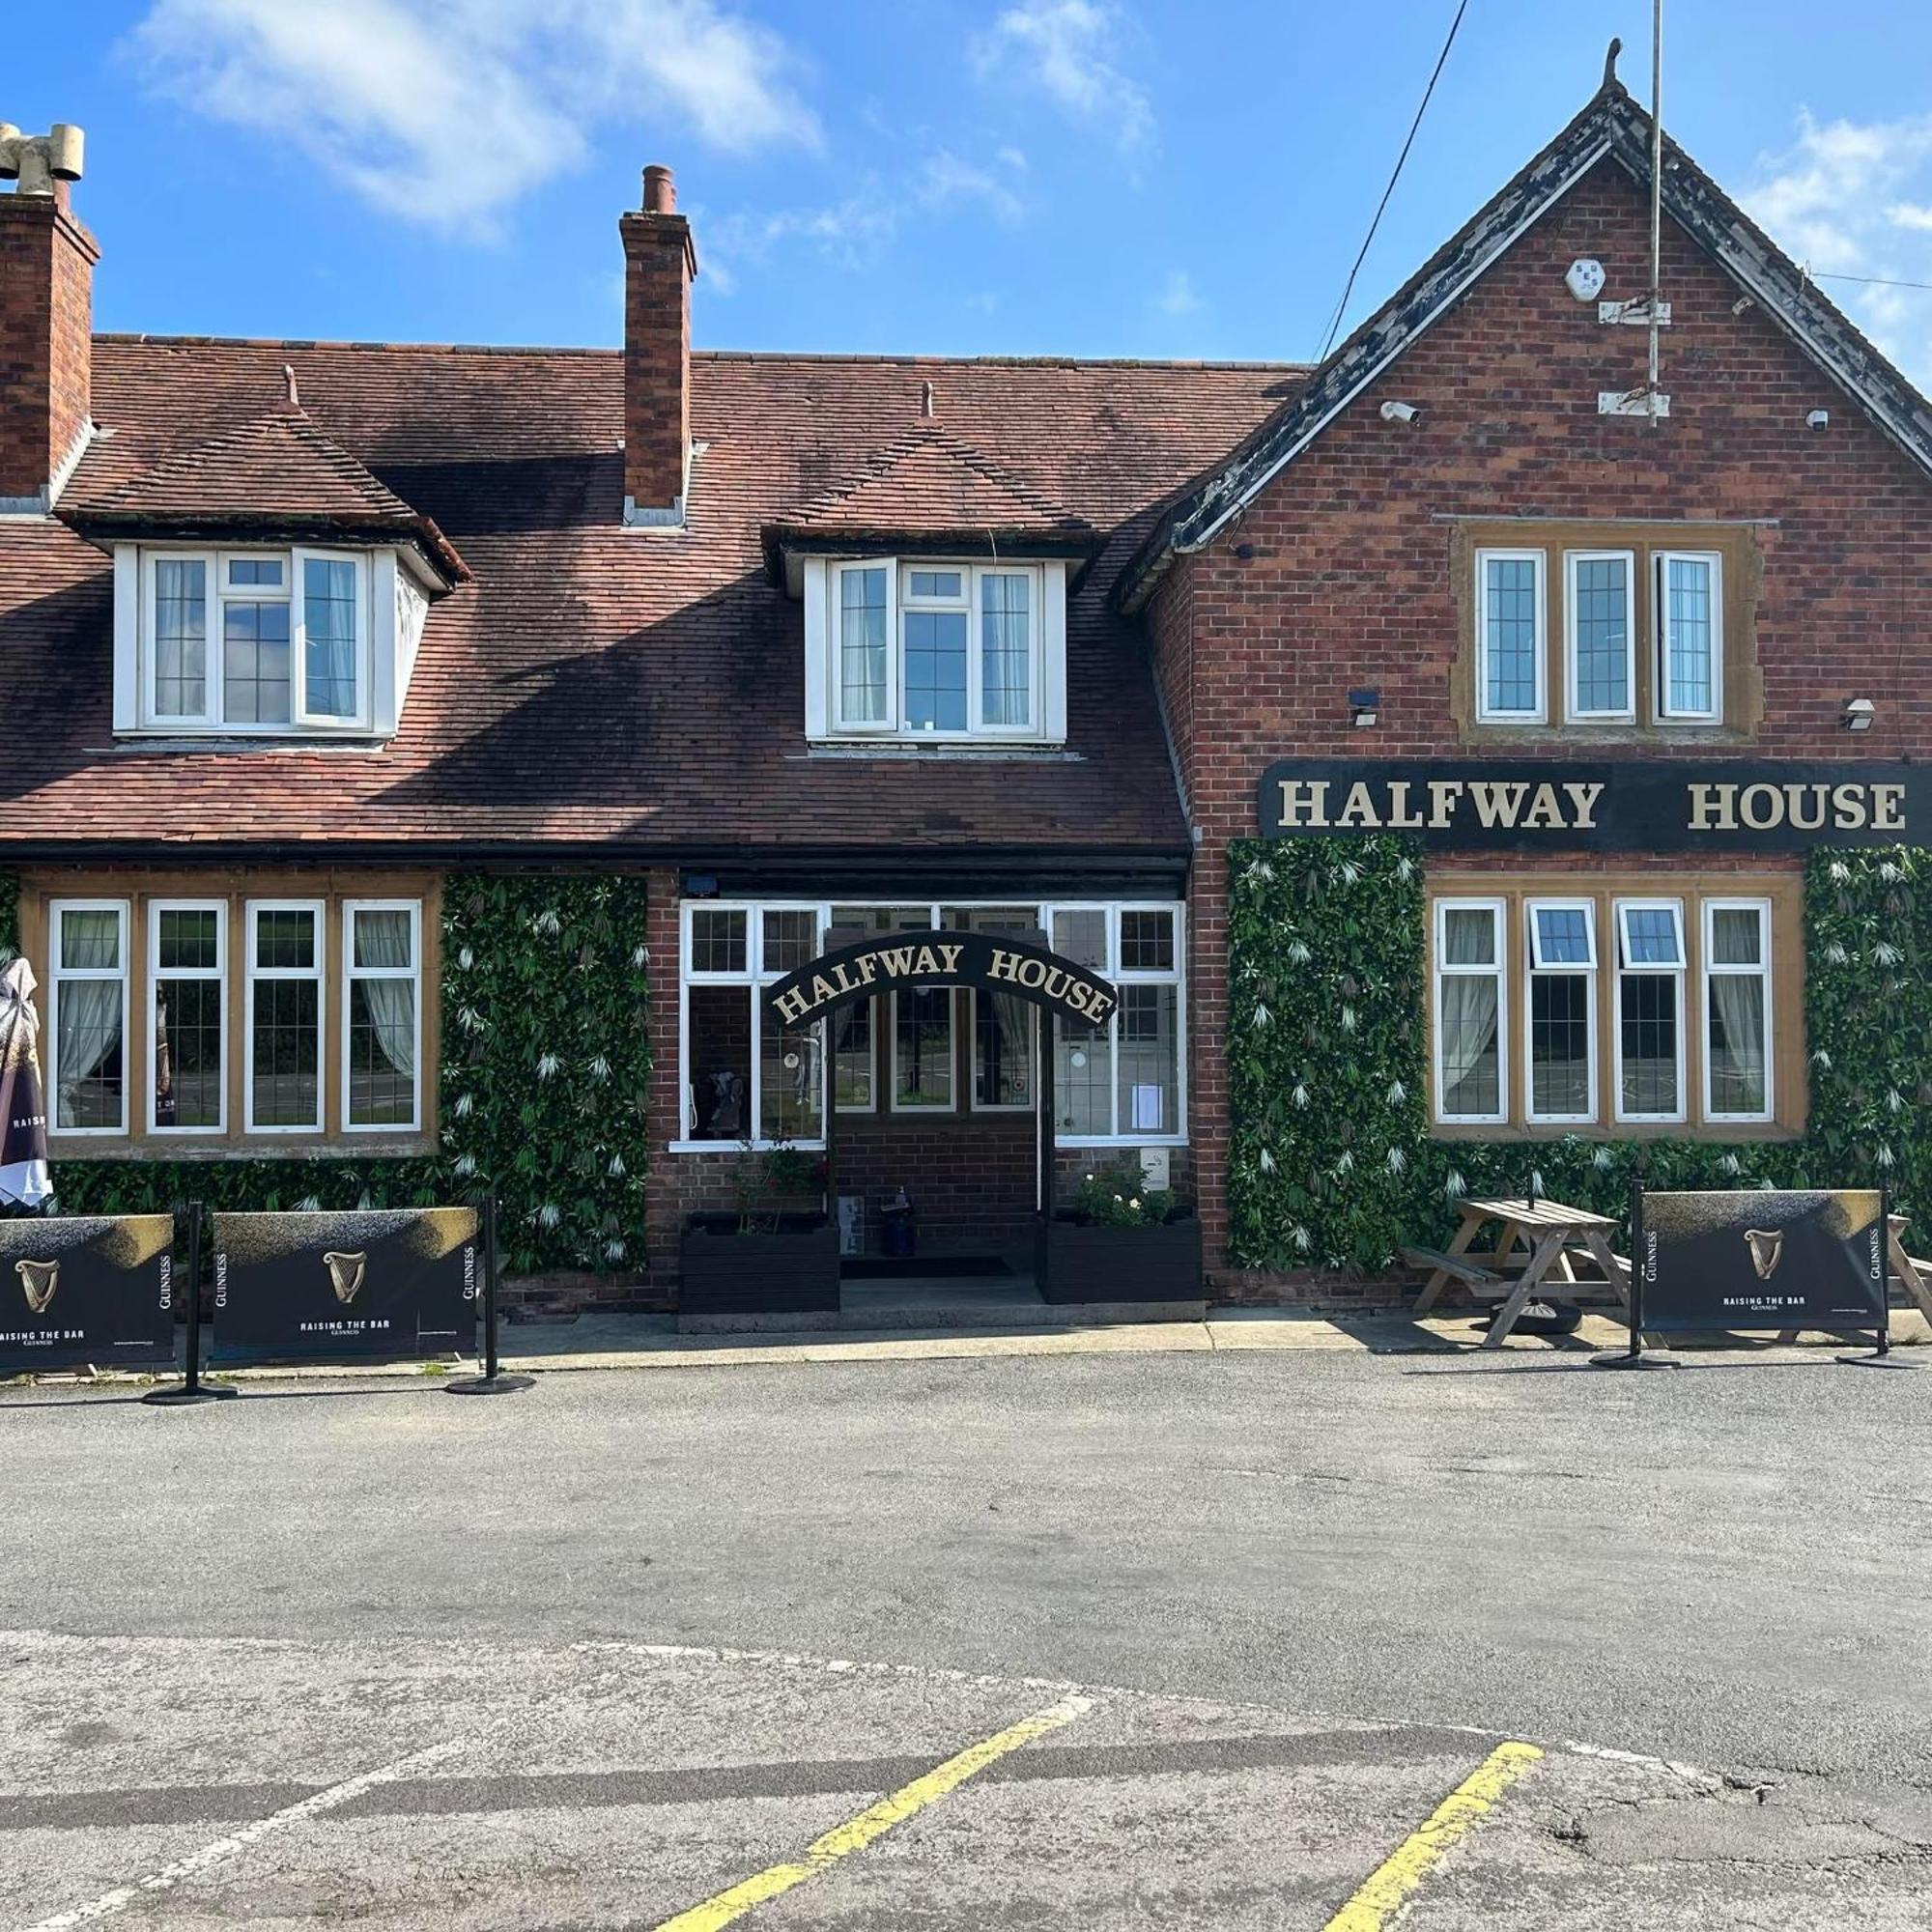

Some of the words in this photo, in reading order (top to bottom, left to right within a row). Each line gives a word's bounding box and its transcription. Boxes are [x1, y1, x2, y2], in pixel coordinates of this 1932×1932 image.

[1277, 780, 1605, 828] HALFWAY
[1687, 782, 1906, 831] HOUSE
[773, 944, 965, 1025] HALFWAY
[986, 948, 1113, 1025] HOUSE
[215, 1253, 227, 1307] GUINNESS
[463, 1246, 474, 1299] GUINNESS
[1646, 1231, 1658, 1282] GUINNESS
[1870, 1228, 1880, 1280] GUINNESS
[159, 1255, 171, 1310] GUINNESS
[0, 1331, 36, 1341] AISING
[40, 1330, 60, 1340] THE
[64, 1329, 84, 1339] BAR
[300, 1321, 343, 1331] RAISING
[347, 1321, 366, 1329] THE
[370, 1320, 390, 1328] BAR
